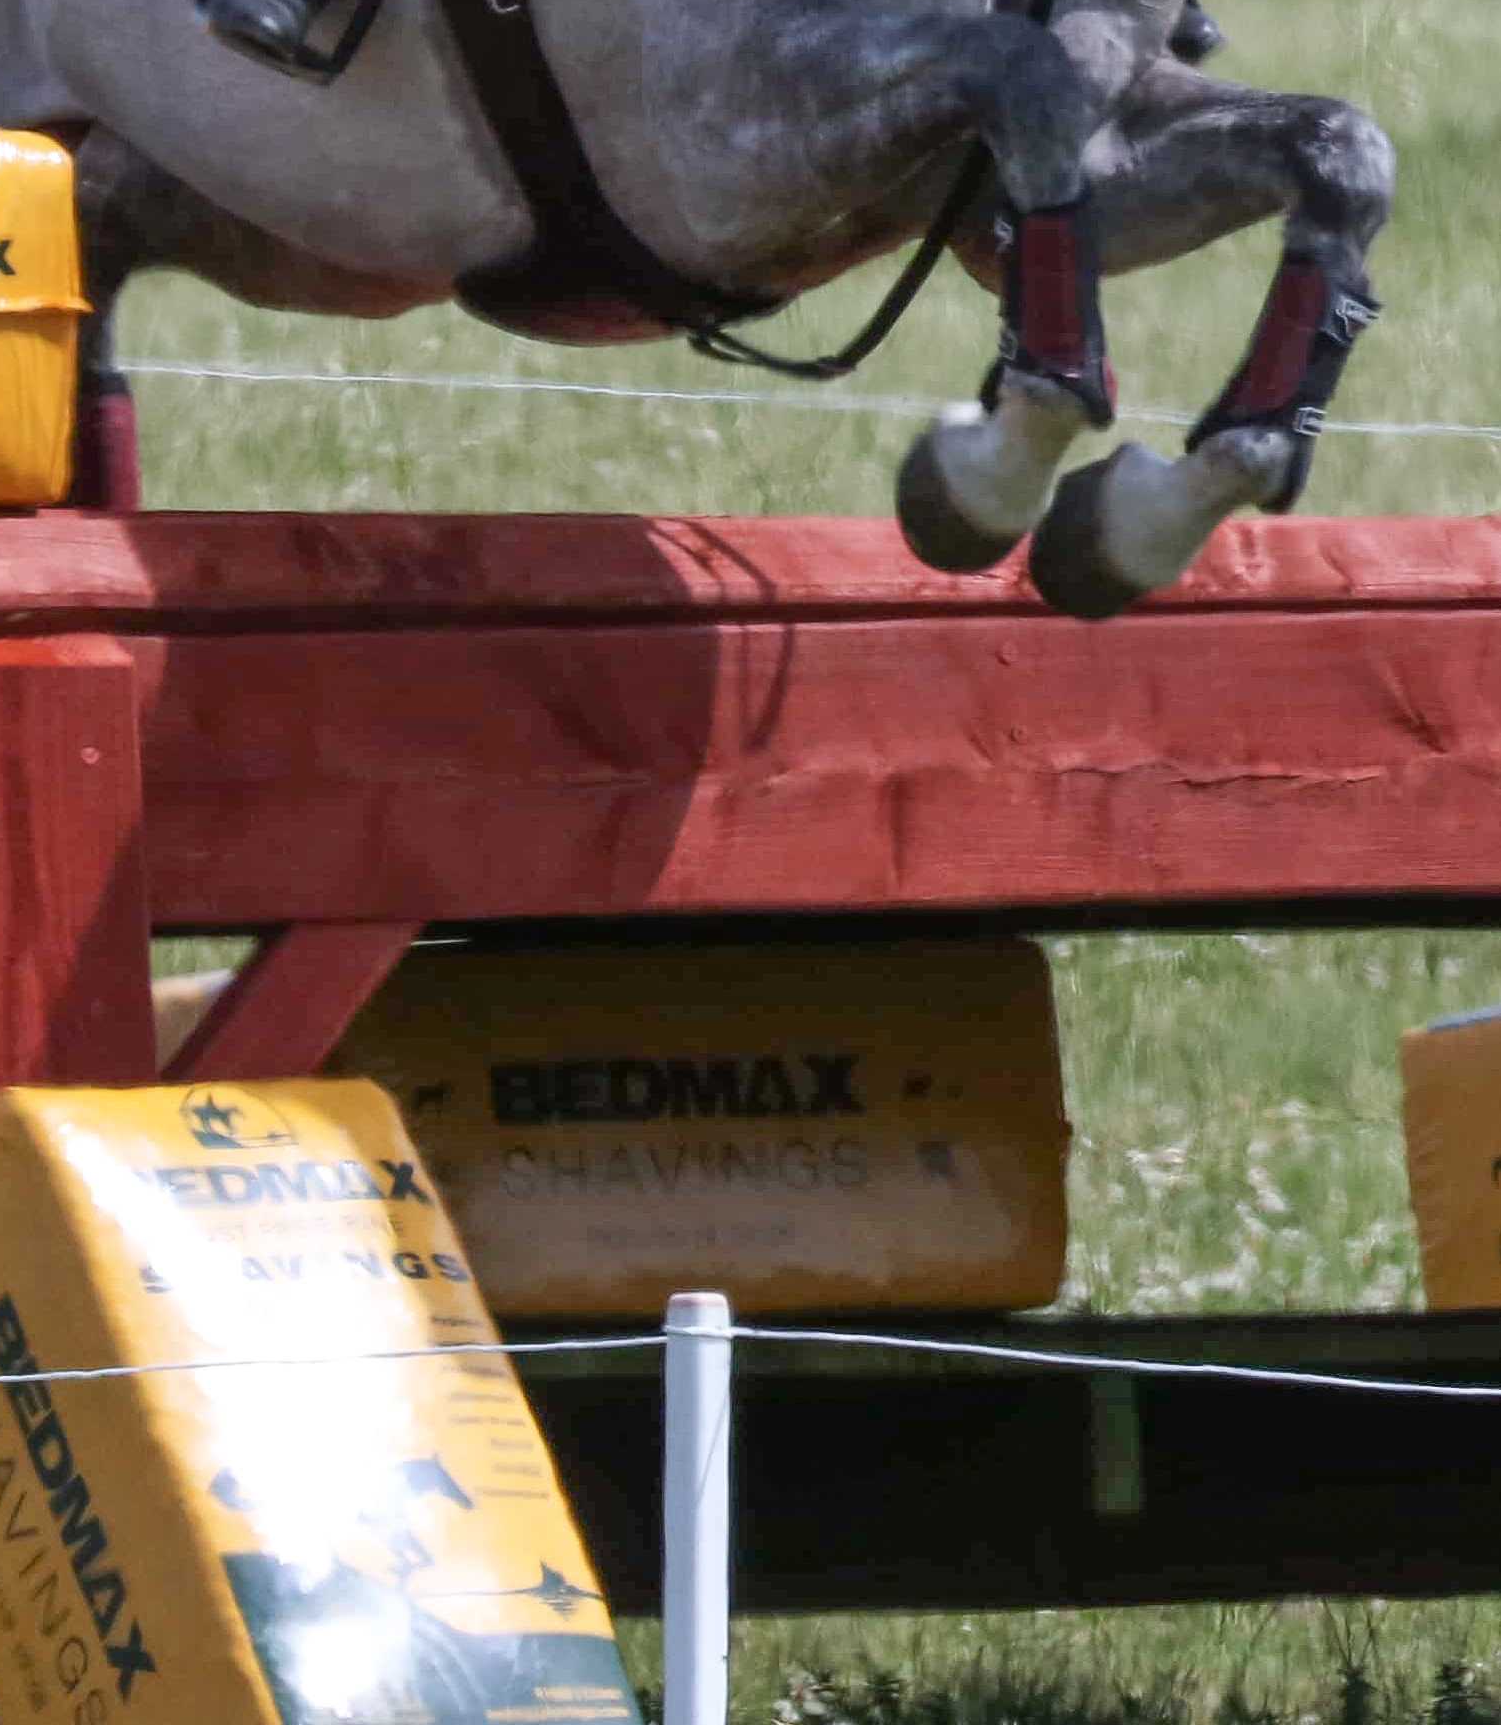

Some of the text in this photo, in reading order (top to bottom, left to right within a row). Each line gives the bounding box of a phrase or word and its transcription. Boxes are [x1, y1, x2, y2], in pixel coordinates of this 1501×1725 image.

[490, 1052, 866, 1124] BEDMAX
[133, 1159, 435, 1209] EDMAX
[500, 1139, 868, 1201] SHAVINGS
